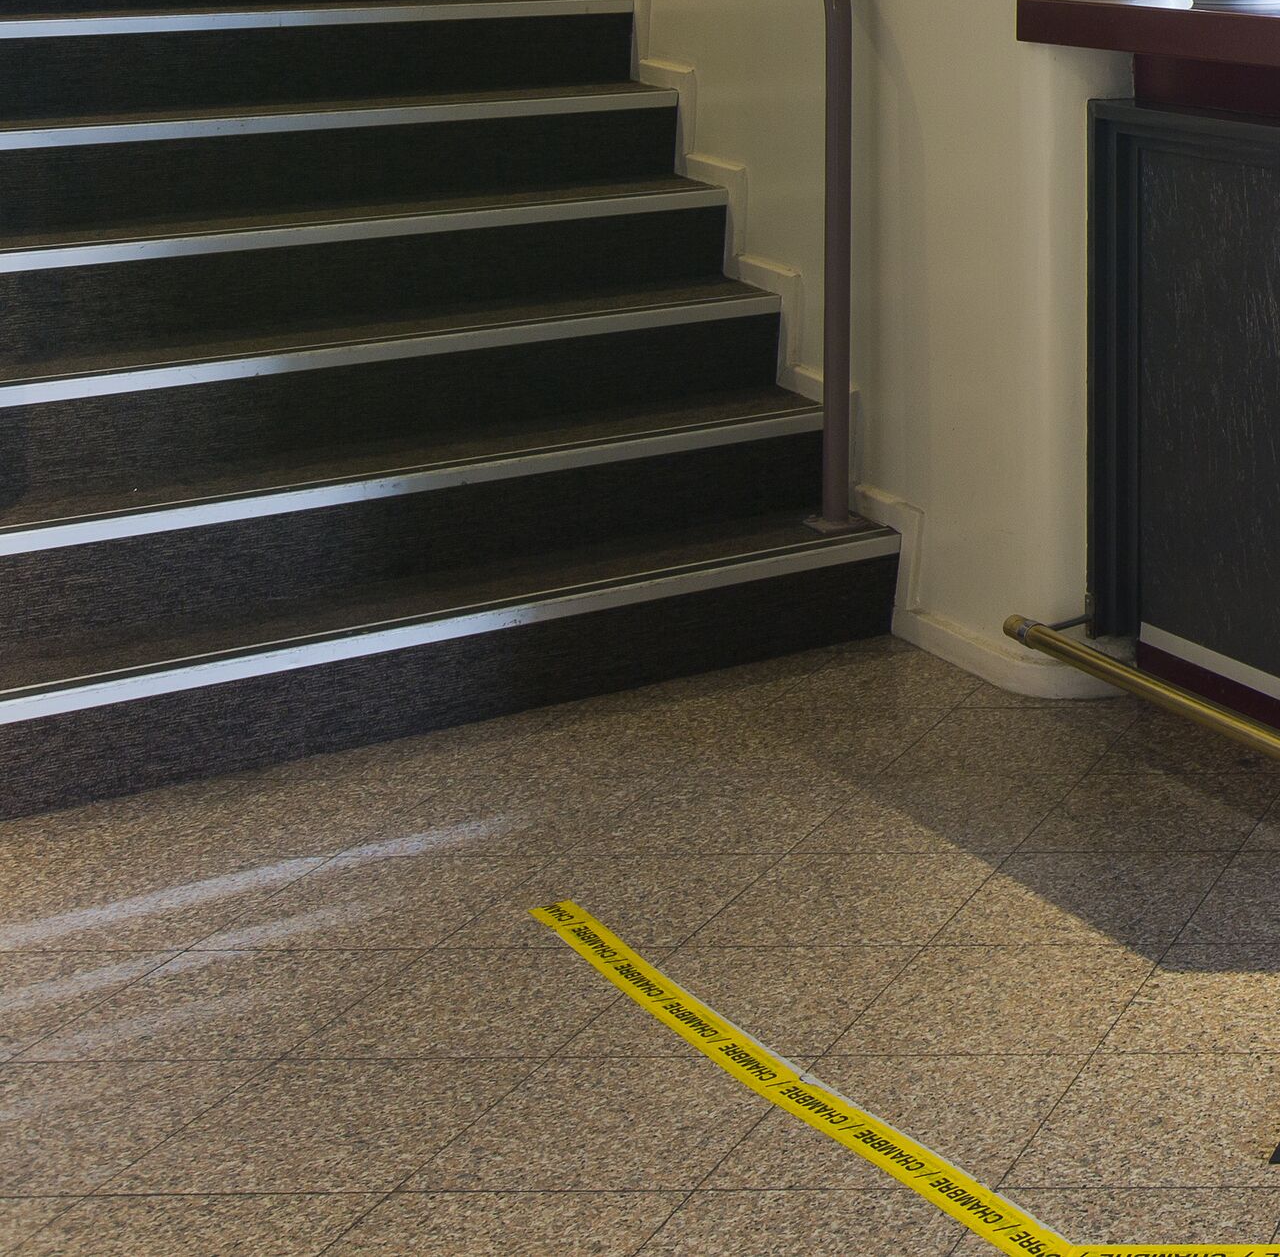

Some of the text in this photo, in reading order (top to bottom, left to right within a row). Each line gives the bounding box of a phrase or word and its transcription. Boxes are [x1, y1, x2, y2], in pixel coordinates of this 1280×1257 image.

[571, 925, 618, 959] CHAMBRE
[614, 963, 665, 997] CHAMBRE
[662, 1002, 719, 1038] CHAMBRE
[719, 1042, 778, 1082] CHAMBRE
[780, 1085, 845, 1125] CHAMBRE
[853, 1128, 926, 1171] CHAMBRE
[929, 1177, 1004, 1224] CHAMBRE
